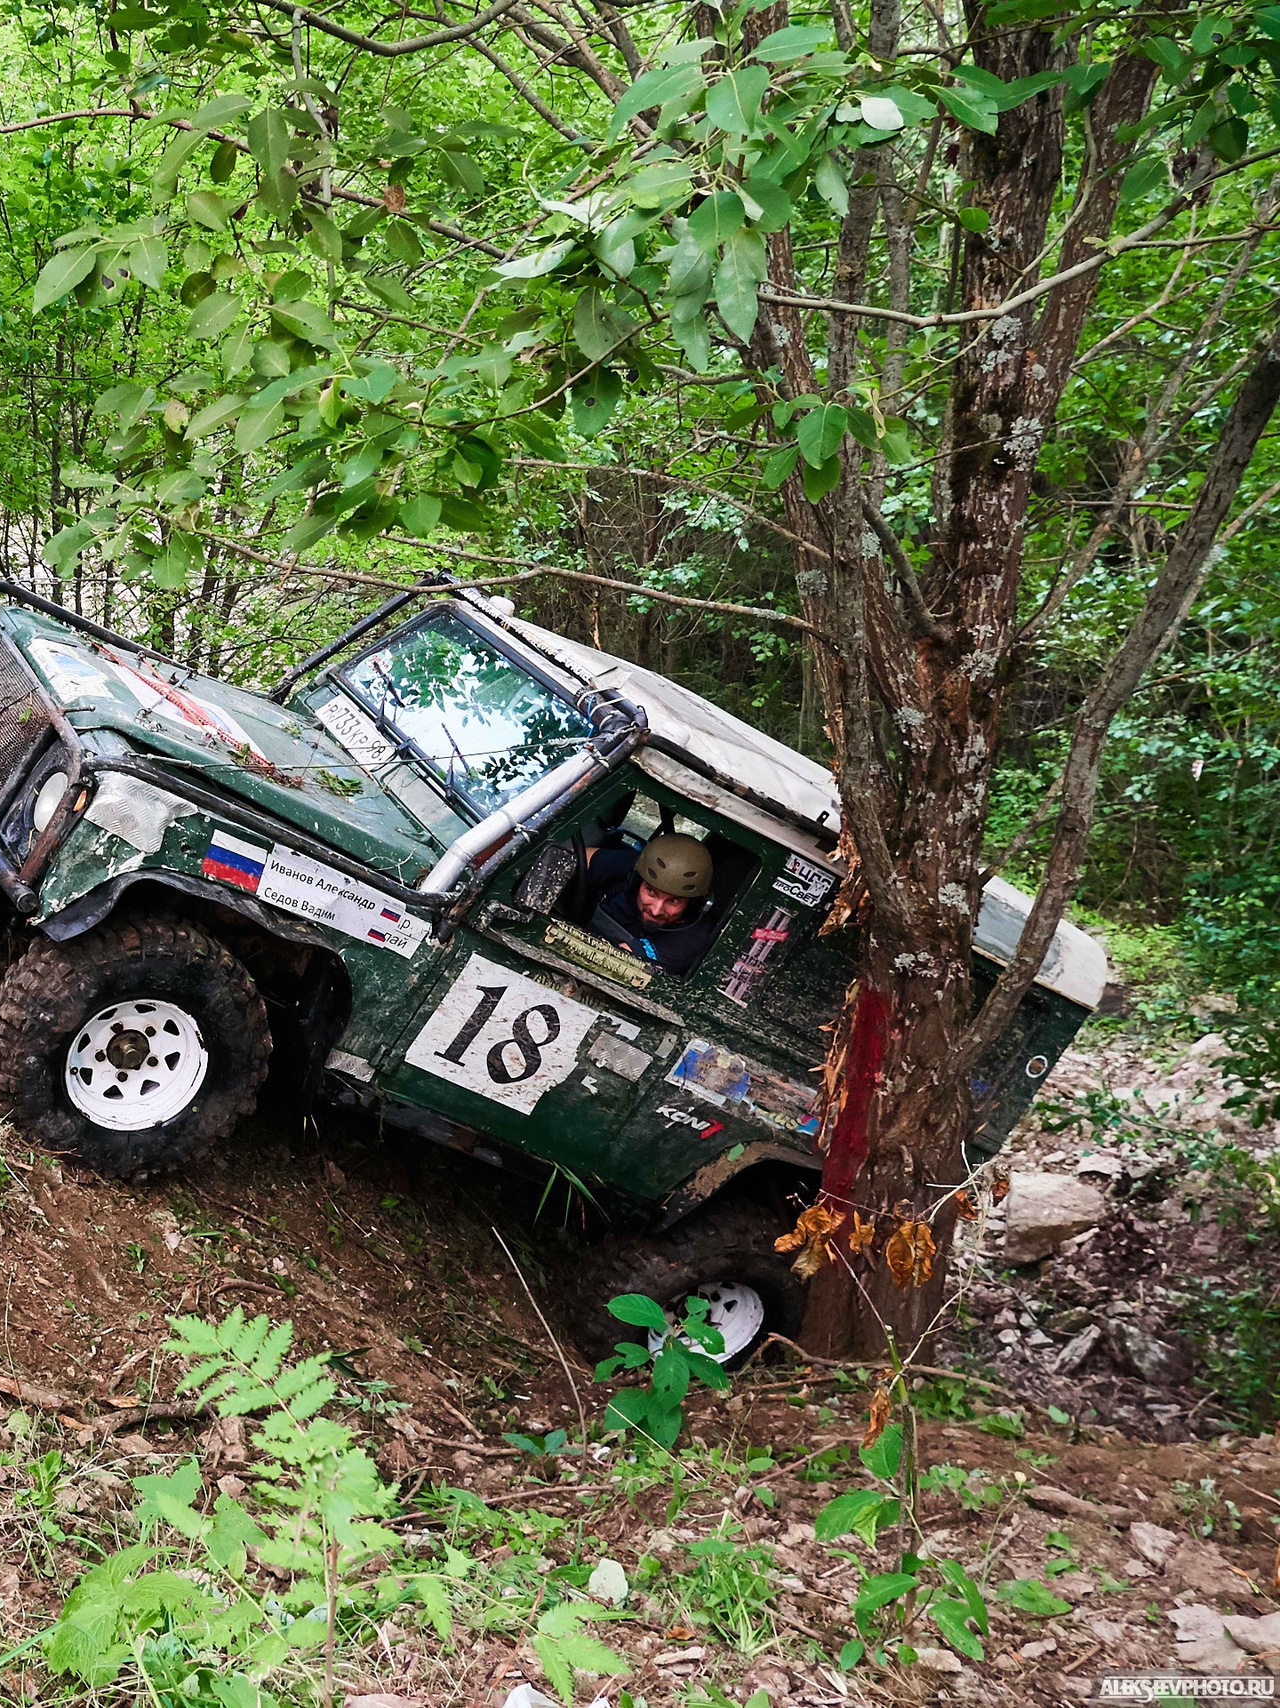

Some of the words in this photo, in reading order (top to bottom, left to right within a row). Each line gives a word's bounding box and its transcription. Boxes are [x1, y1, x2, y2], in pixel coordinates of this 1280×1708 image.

[264, 887, 299, 908] Седов
[300, 900, 336, 921] Вадим
[270, 859, 314, 885] Иванов
[315, 878, 376, 911] Александр
[433, 985, 561, 1084] 18
